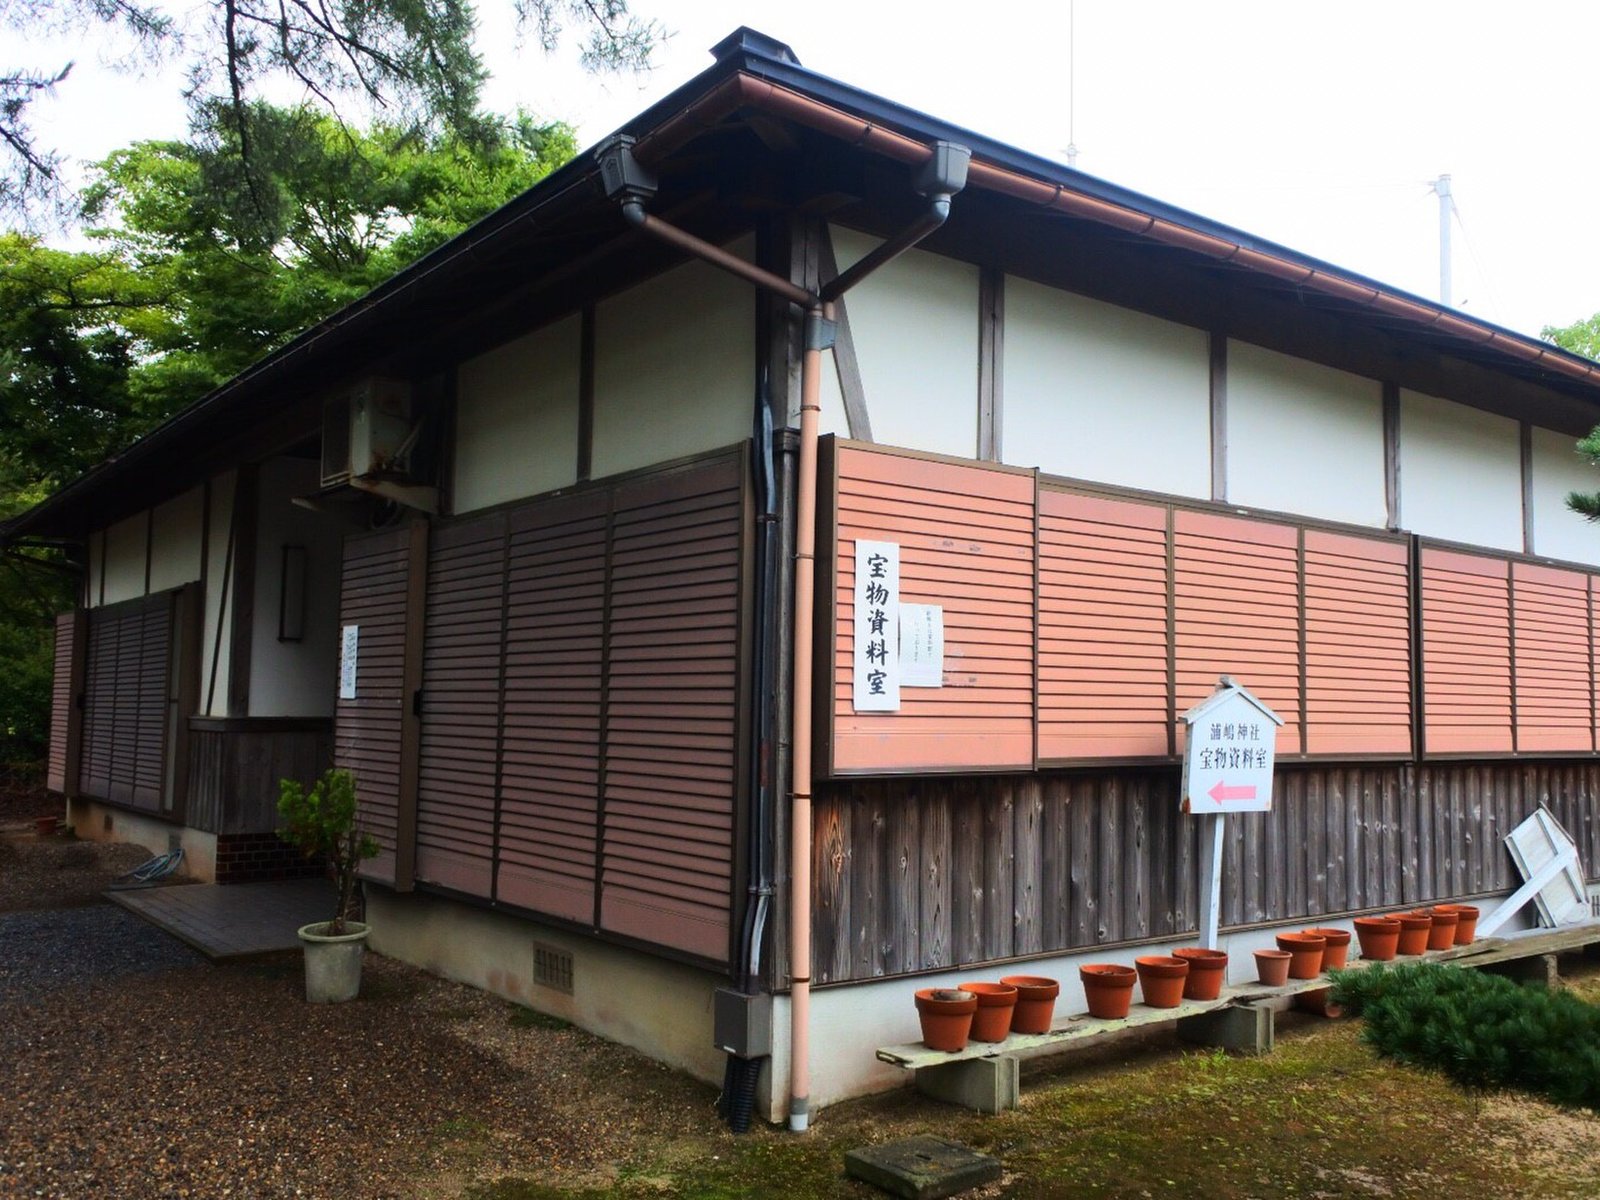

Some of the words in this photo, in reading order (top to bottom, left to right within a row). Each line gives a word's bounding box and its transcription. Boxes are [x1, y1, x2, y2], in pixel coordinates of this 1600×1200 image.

[866, 553, 889, 695] 宝物資料室
[1199, 747, 1267, 770] 宝物資料室
